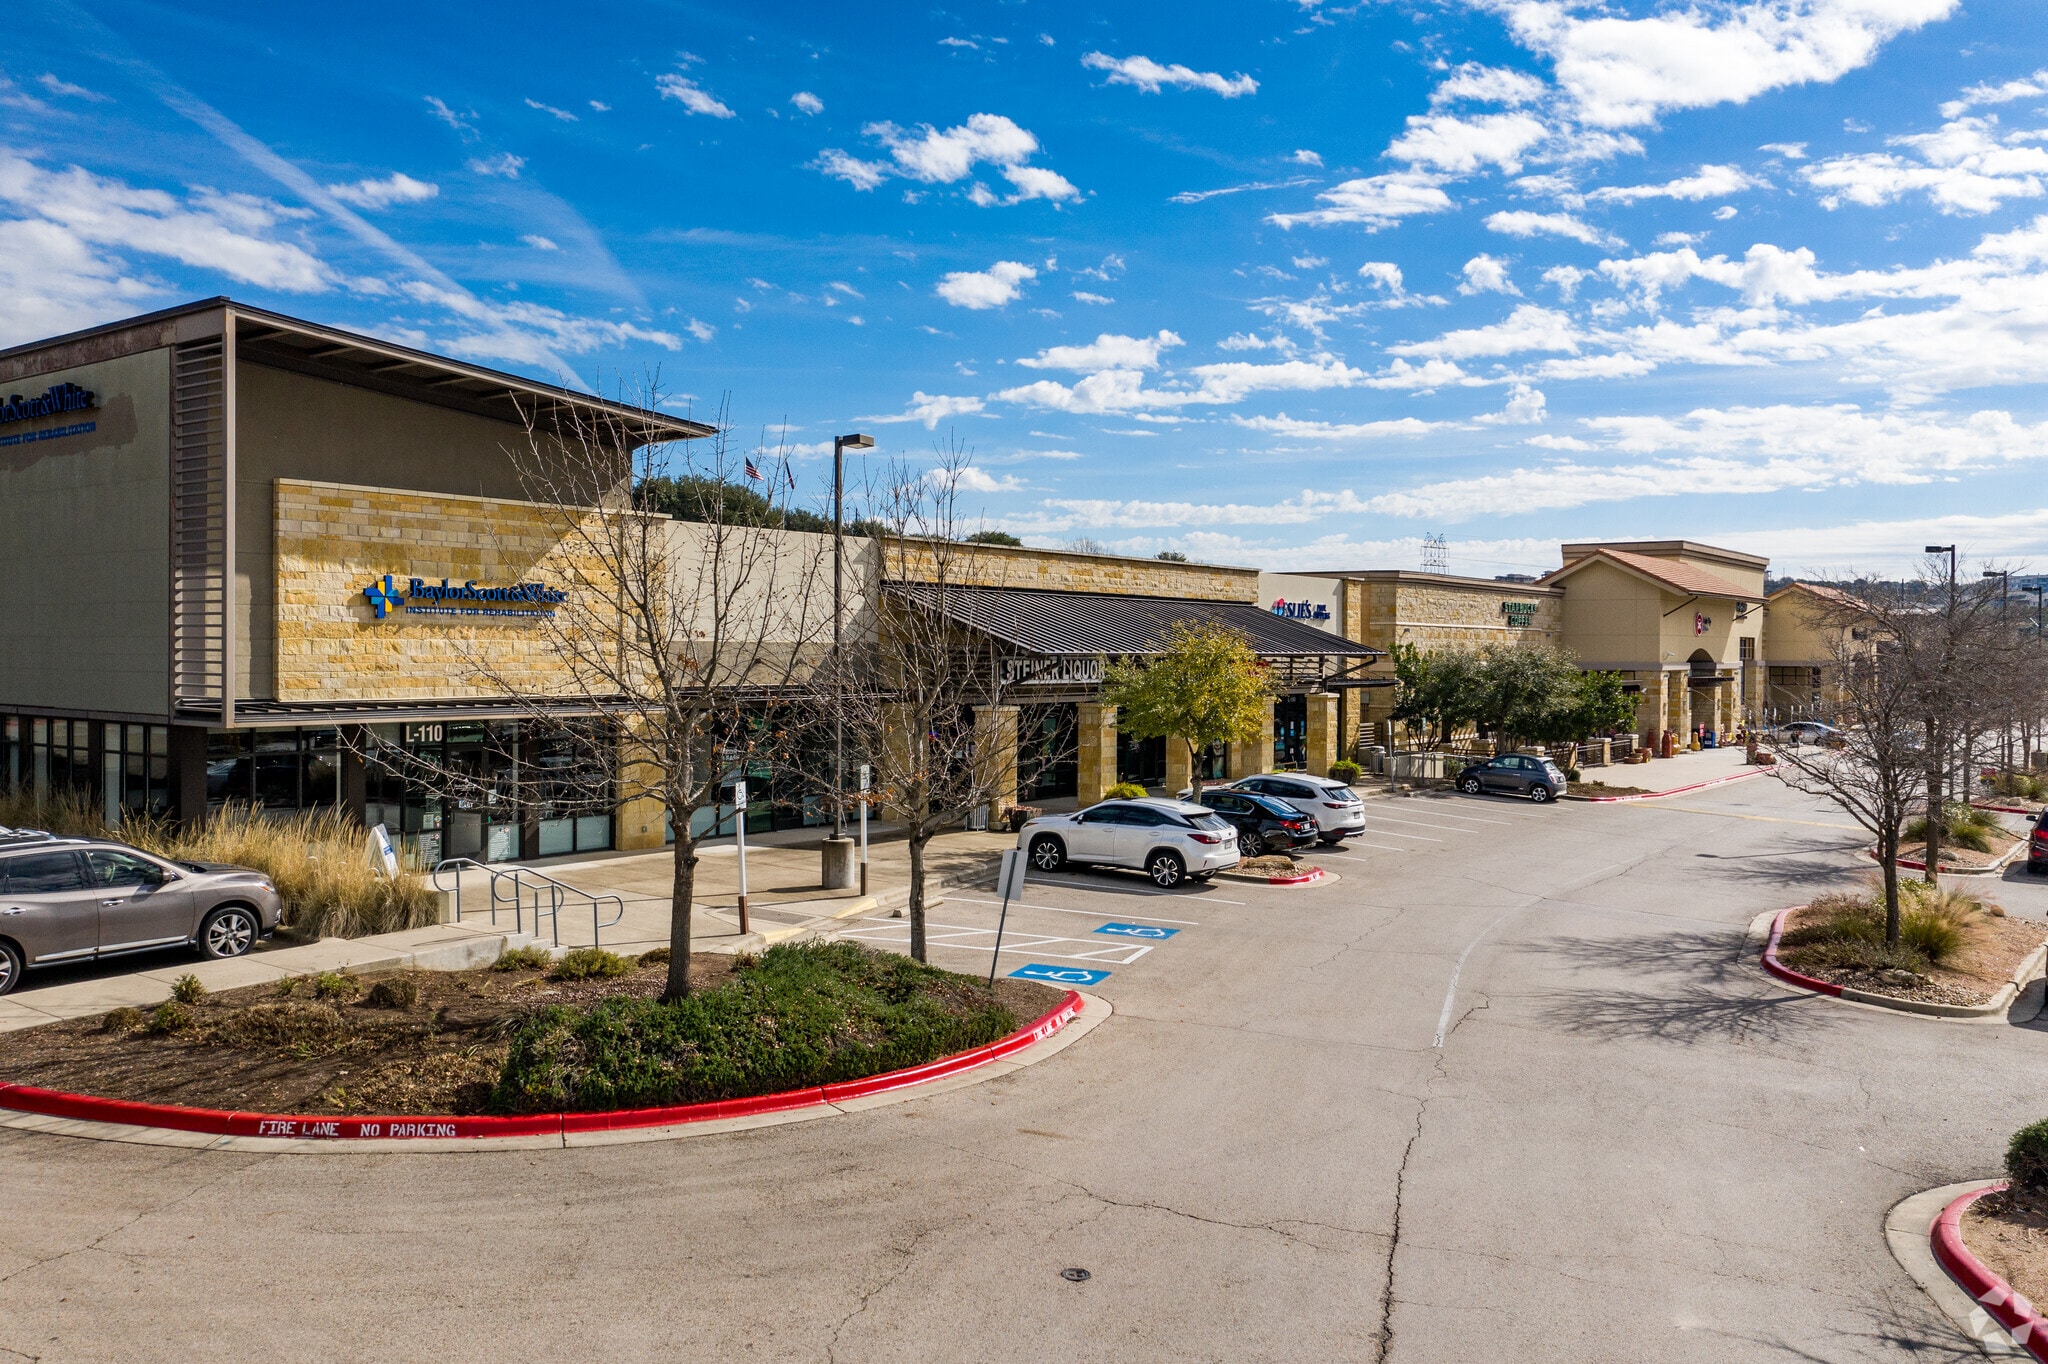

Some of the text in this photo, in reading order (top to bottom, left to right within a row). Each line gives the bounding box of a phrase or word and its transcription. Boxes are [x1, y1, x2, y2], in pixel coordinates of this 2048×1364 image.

[405, 605, 457, 616] INSTITUTE
[460, 606, 480, 616] FOR
[405, 724, 443, 742] L-110
[259, 1120, 456, 1137] FIRE LANE NO PARKING
